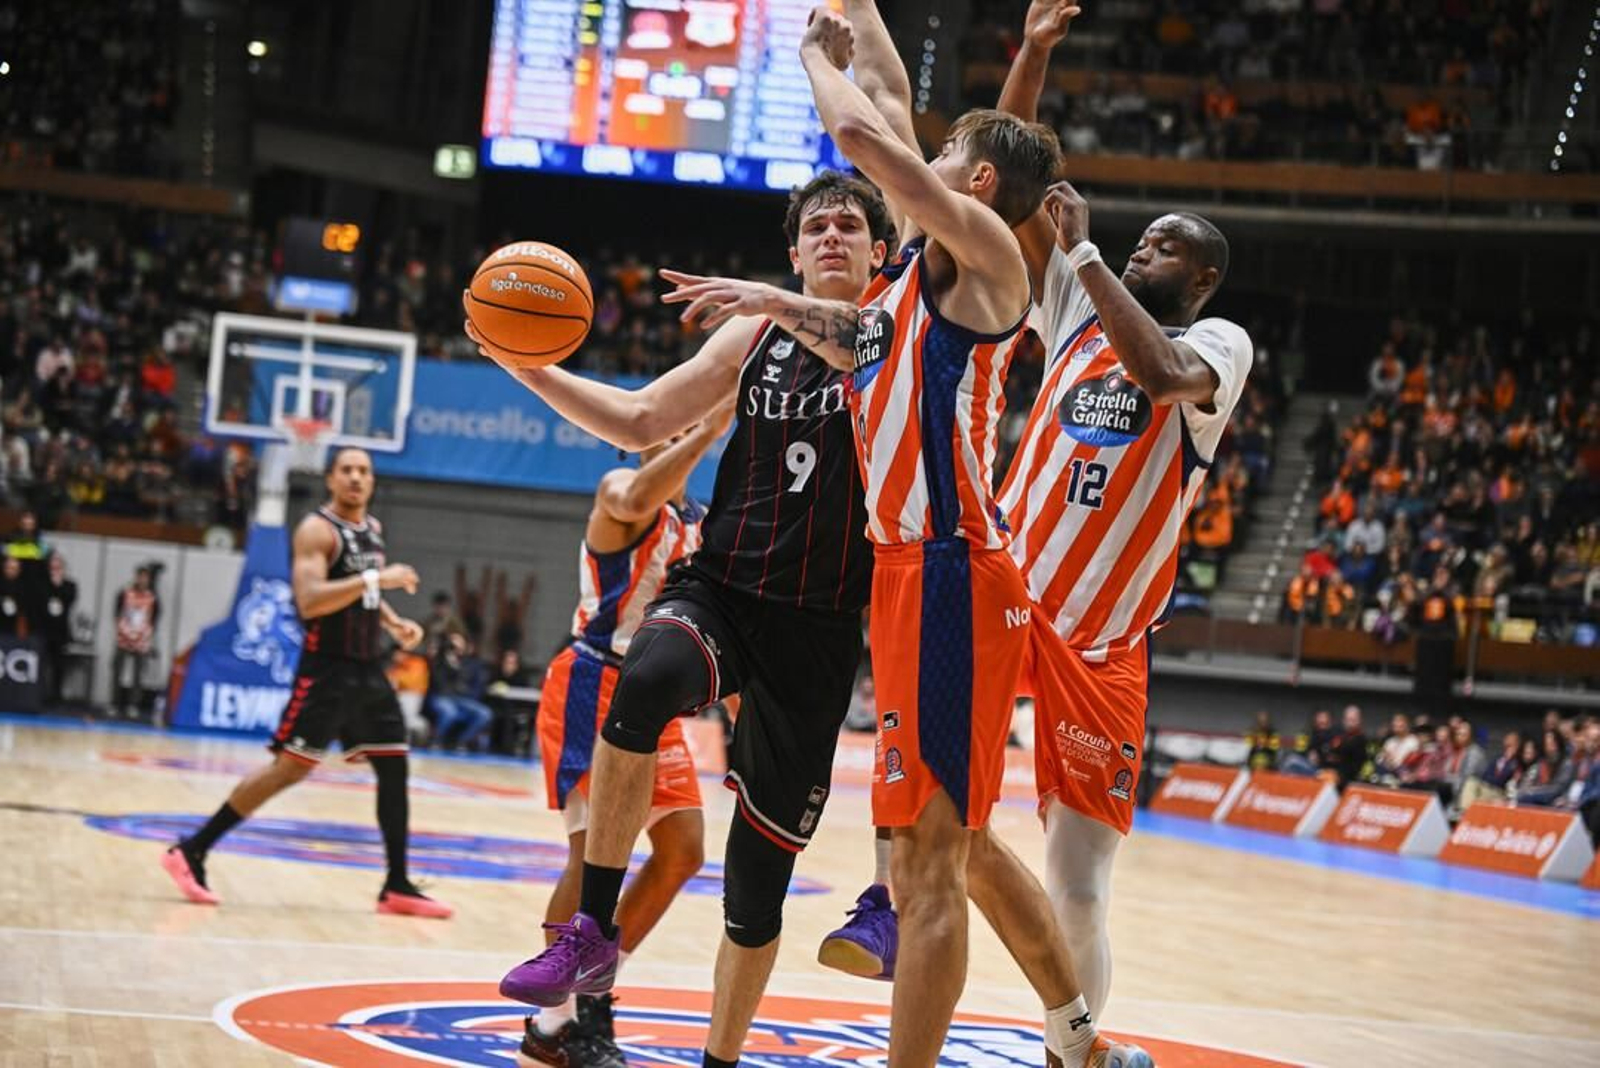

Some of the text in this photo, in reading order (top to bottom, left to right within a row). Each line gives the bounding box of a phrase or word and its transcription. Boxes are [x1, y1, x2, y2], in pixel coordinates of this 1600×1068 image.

[1073, 387, 1138, 412] Estrella
[1071, 405, 1131, 431] Galicia
[785, 441, 817, 493] 9
[1066, 459, 1108, 509] 12
[1056, 720, 1113, 752] A Coruña
